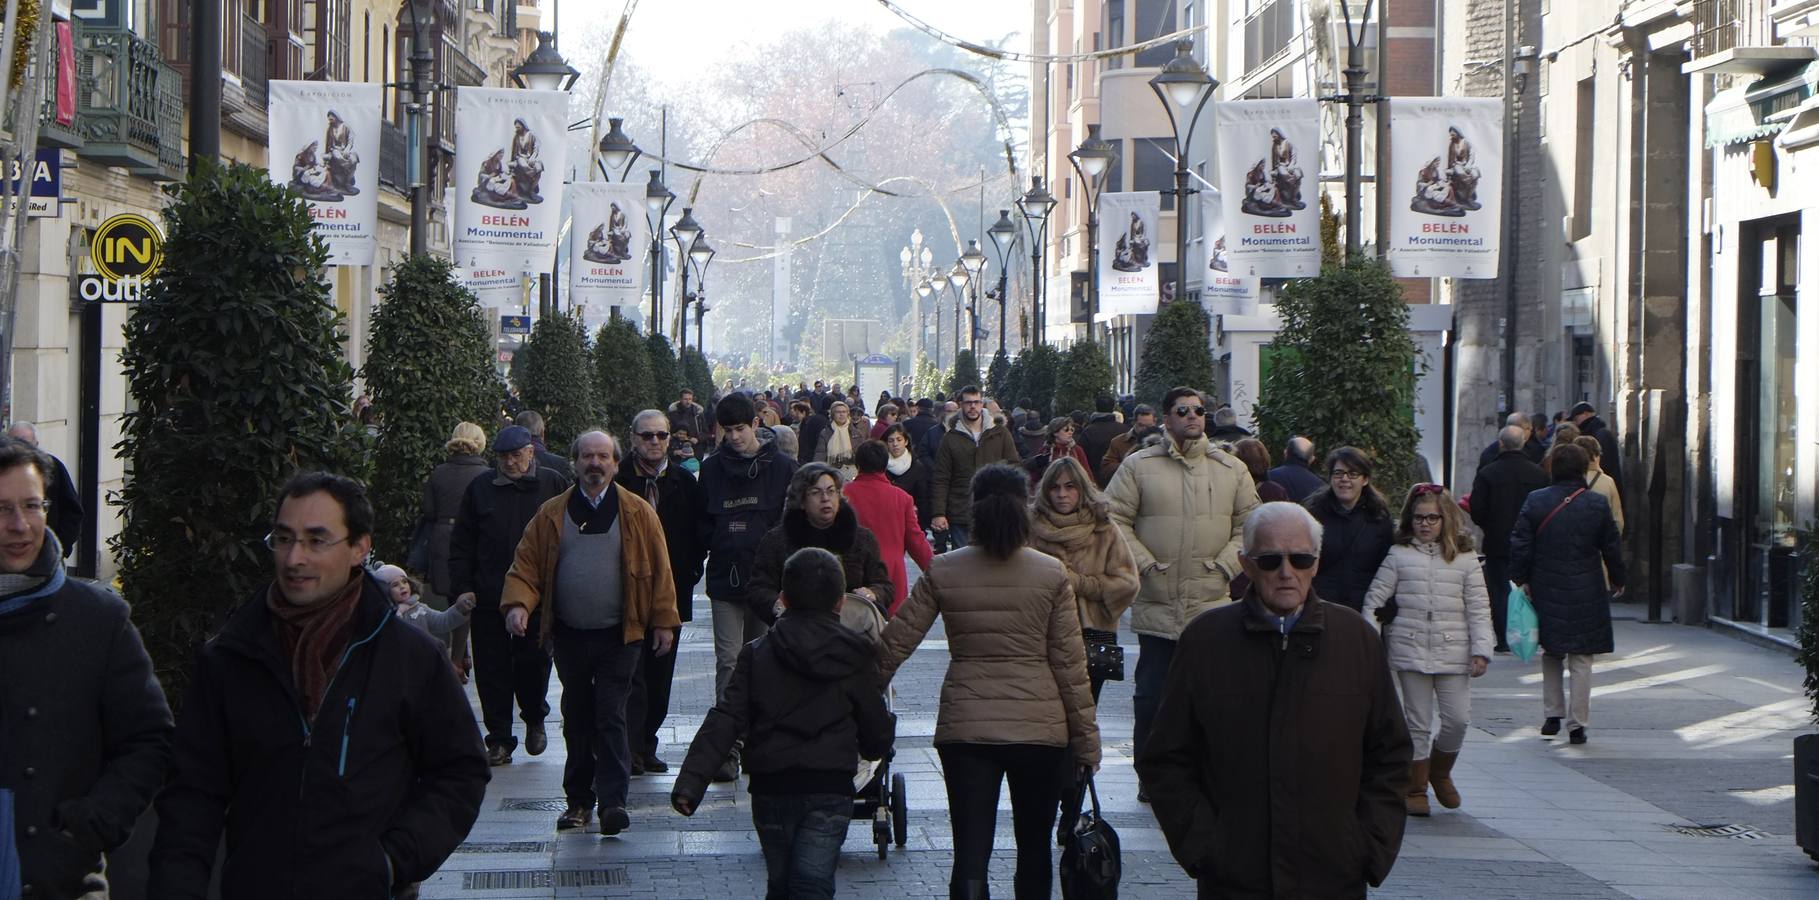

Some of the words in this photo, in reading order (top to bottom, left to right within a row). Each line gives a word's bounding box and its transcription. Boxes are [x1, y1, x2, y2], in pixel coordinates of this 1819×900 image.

[307, 207, 347, 220] ELÉN
[481, 214, 530, 227] BELÉN
[1254, 222, 1296, 235] BELÉN
[1422, 221, 1469, 234] BELÉN
[466, 228, 543, 241] Monumental
[1408, 236, 1484, 246] Monumental
[1241, 237, 1310, 246] Monumental
[105, 237, 151, 264] IN
[591, 268, 624, 277] BELÉN
[581, 277, 633, 285] Monumental
